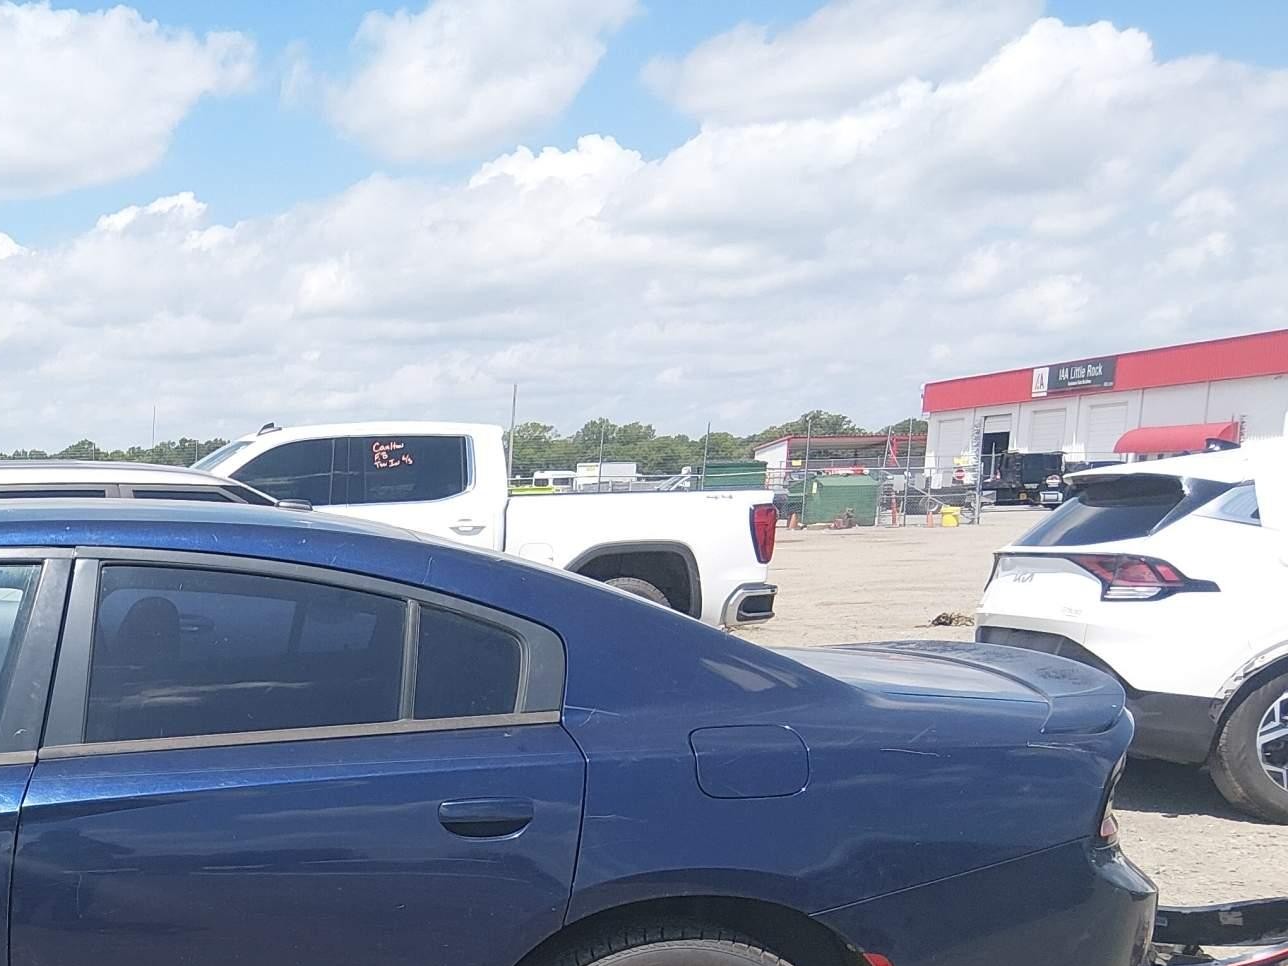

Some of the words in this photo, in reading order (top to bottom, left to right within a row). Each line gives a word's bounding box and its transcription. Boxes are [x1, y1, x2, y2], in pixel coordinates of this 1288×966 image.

[1058, 367, 1069, 381] IAA
[1070, 365, 1086, 380] Little
[1087, 362, 1103, 377] Rock
